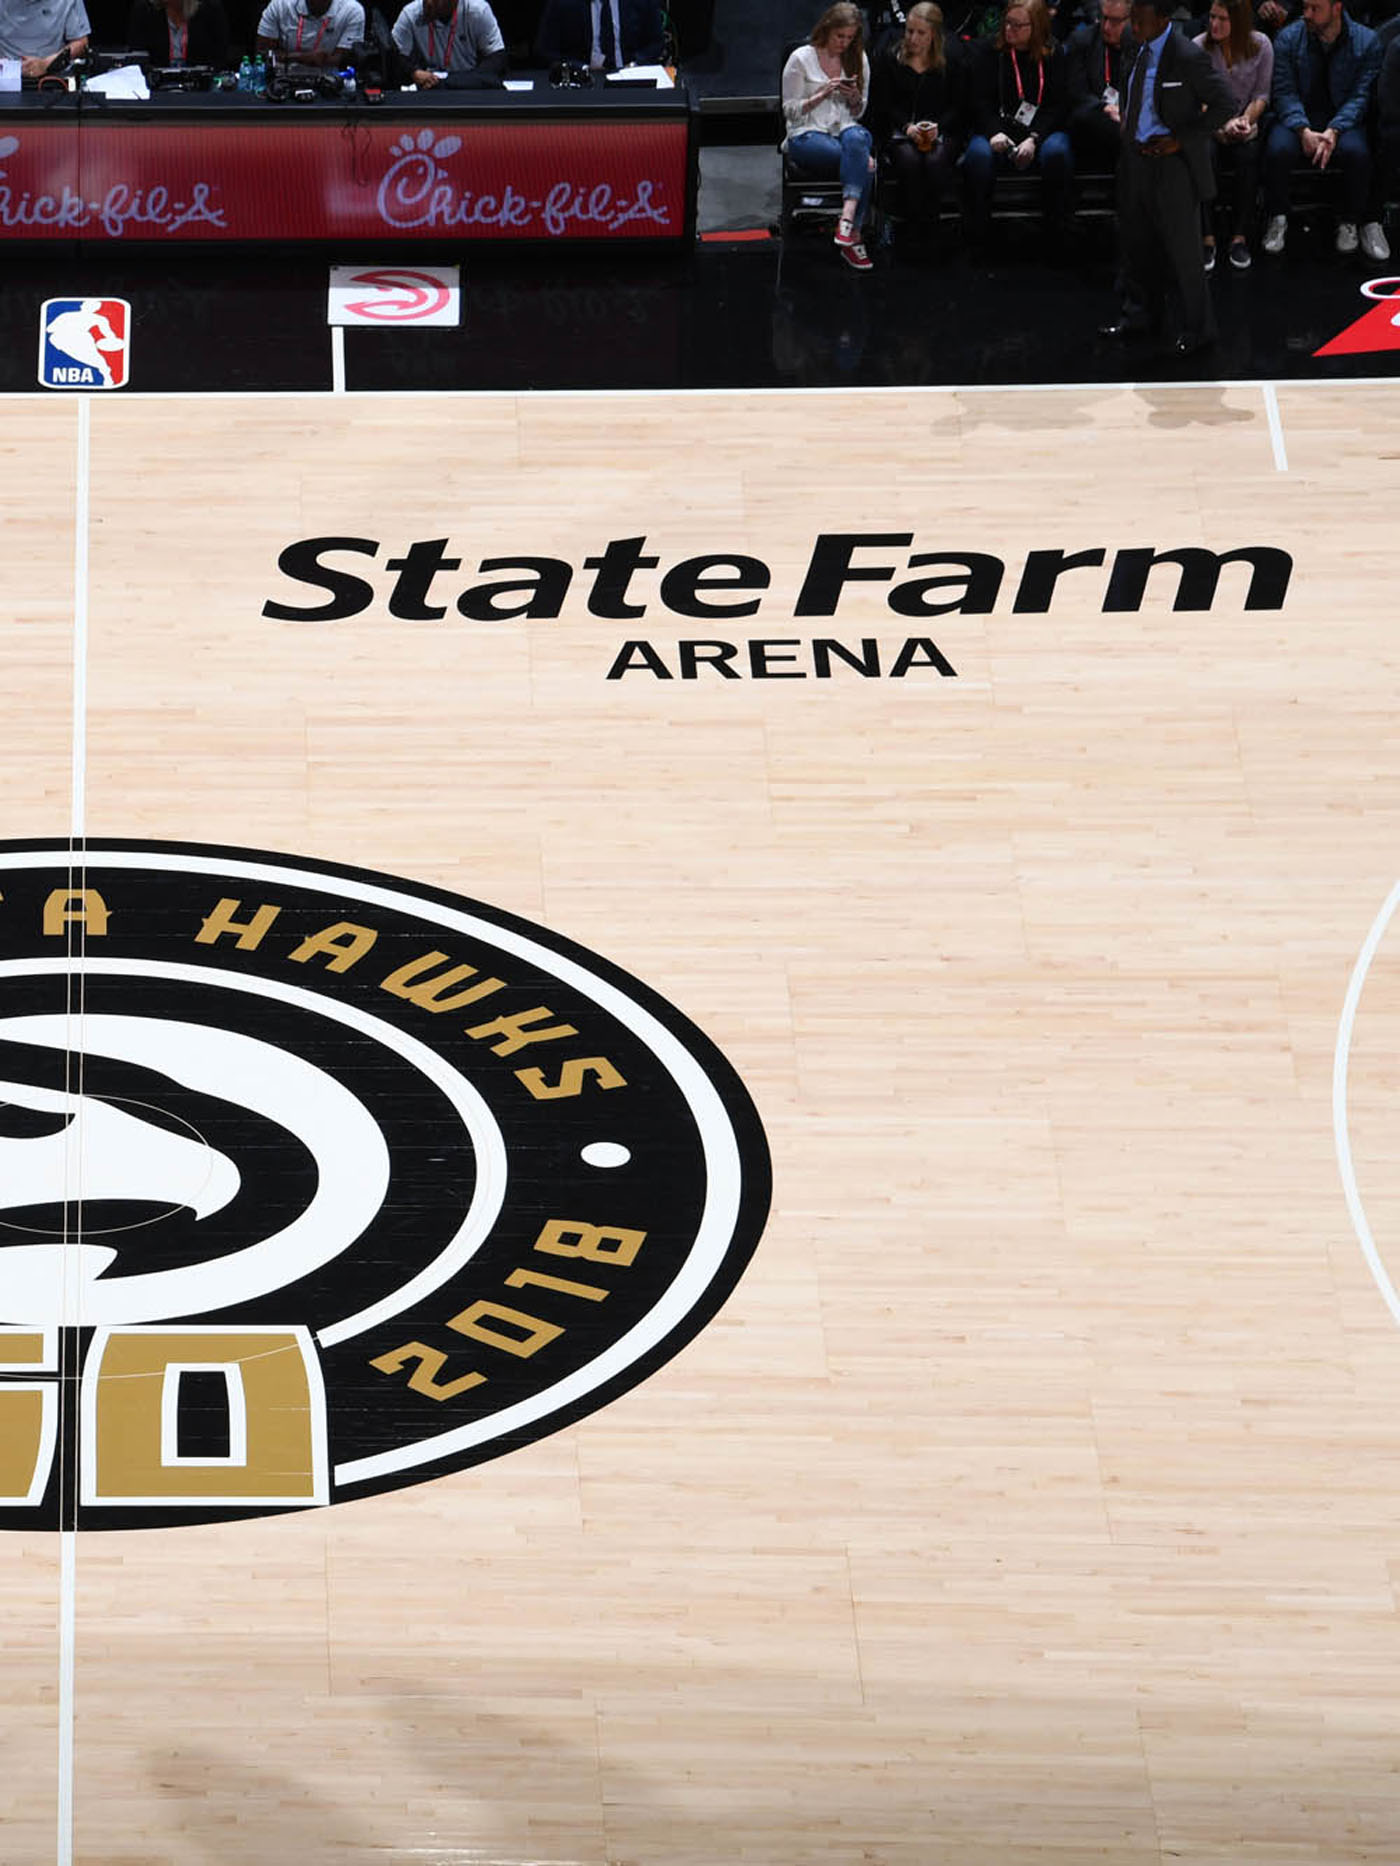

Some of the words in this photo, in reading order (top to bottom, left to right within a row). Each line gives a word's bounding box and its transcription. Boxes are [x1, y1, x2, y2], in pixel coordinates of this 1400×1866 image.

[377, 153, 670, 234] Chick-fil-A
[52, 367, 94, 383] NBA
[606, 637, 958, 680] ARENA
[194, 897, 628, 1101] HAWKS
[369, 1219, 648, 1402] 2018
